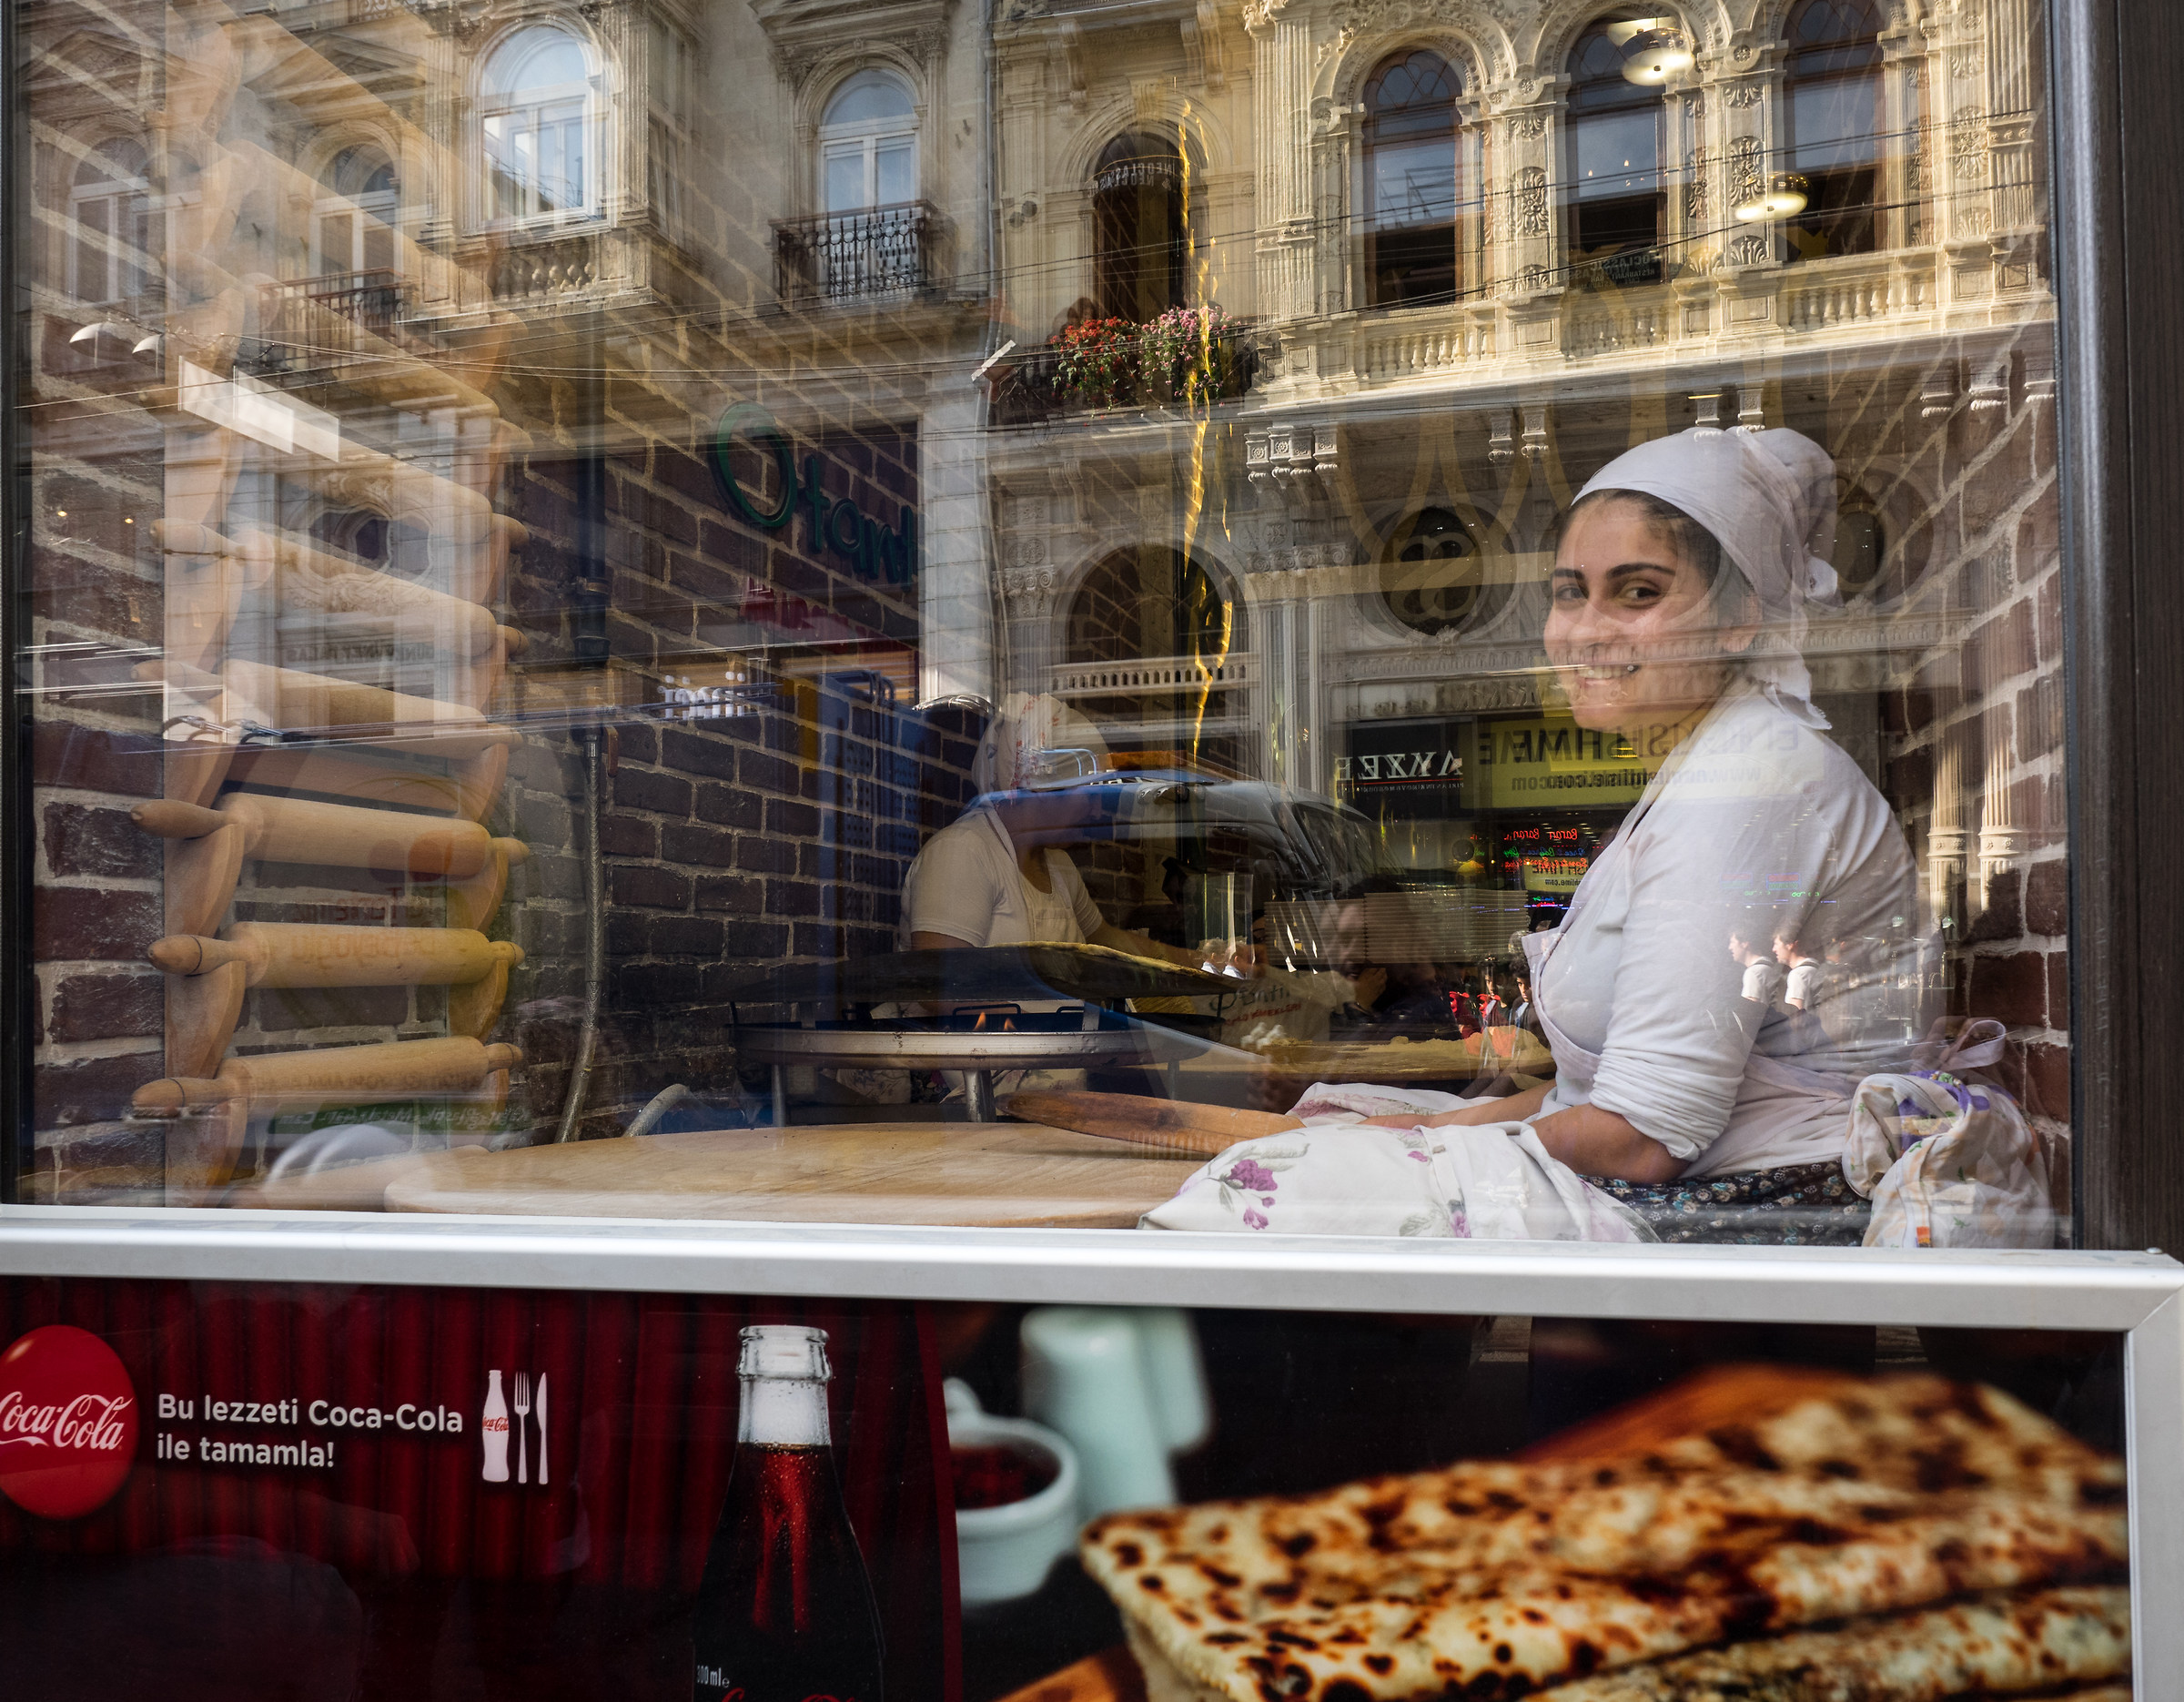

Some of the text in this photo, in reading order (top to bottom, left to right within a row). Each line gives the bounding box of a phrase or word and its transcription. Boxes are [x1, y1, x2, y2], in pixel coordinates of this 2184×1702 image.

[0, 1391, 134, 1451] Coca-Cola
[158, 1393, 463, 1433] Bu lezzeti Coca-Cola
[157, 1433, 334, 1468] ile tamamla!
